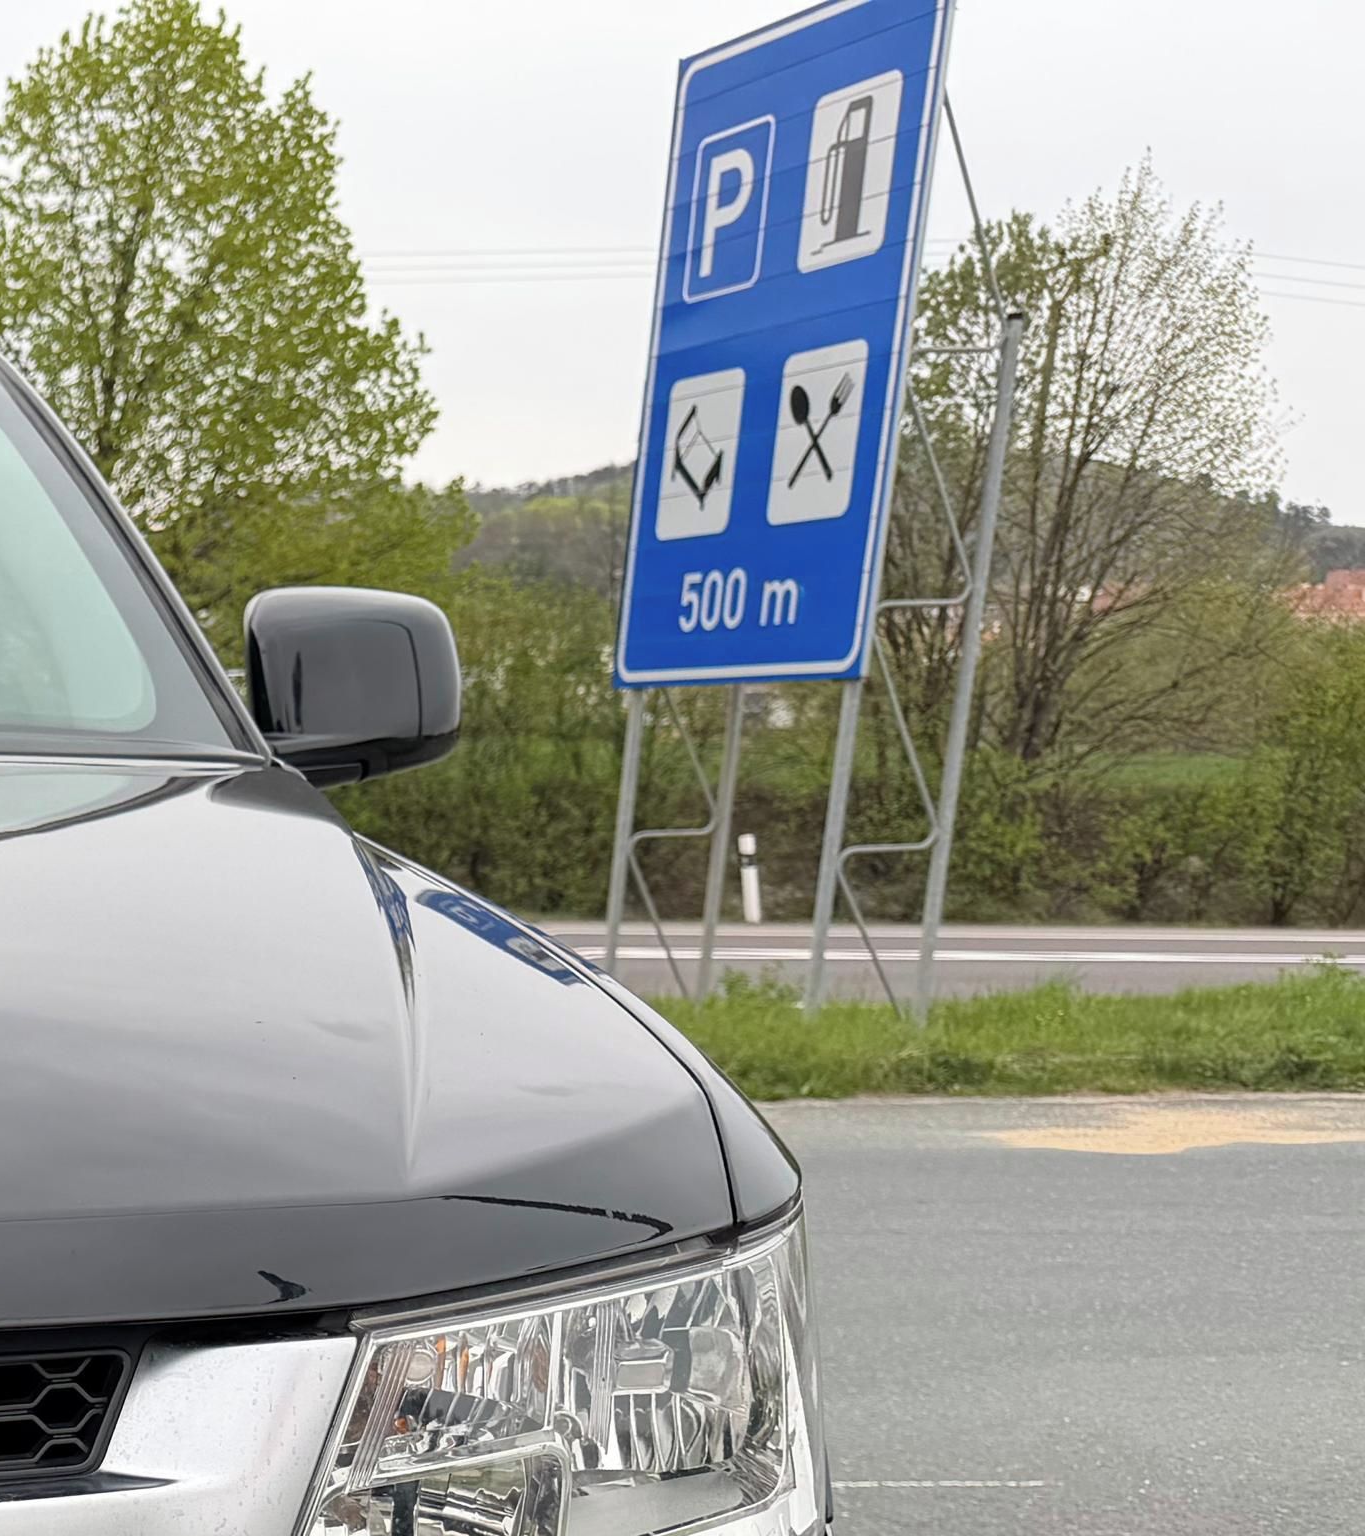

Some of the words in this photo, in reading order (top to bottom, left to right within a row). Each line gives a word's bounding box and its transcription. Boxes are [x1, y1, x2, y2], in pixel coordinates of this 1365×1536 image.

[699, 149, 754, 278] P
[679, 567, 747, 633] 500
[759, 578, 799, 627] m
